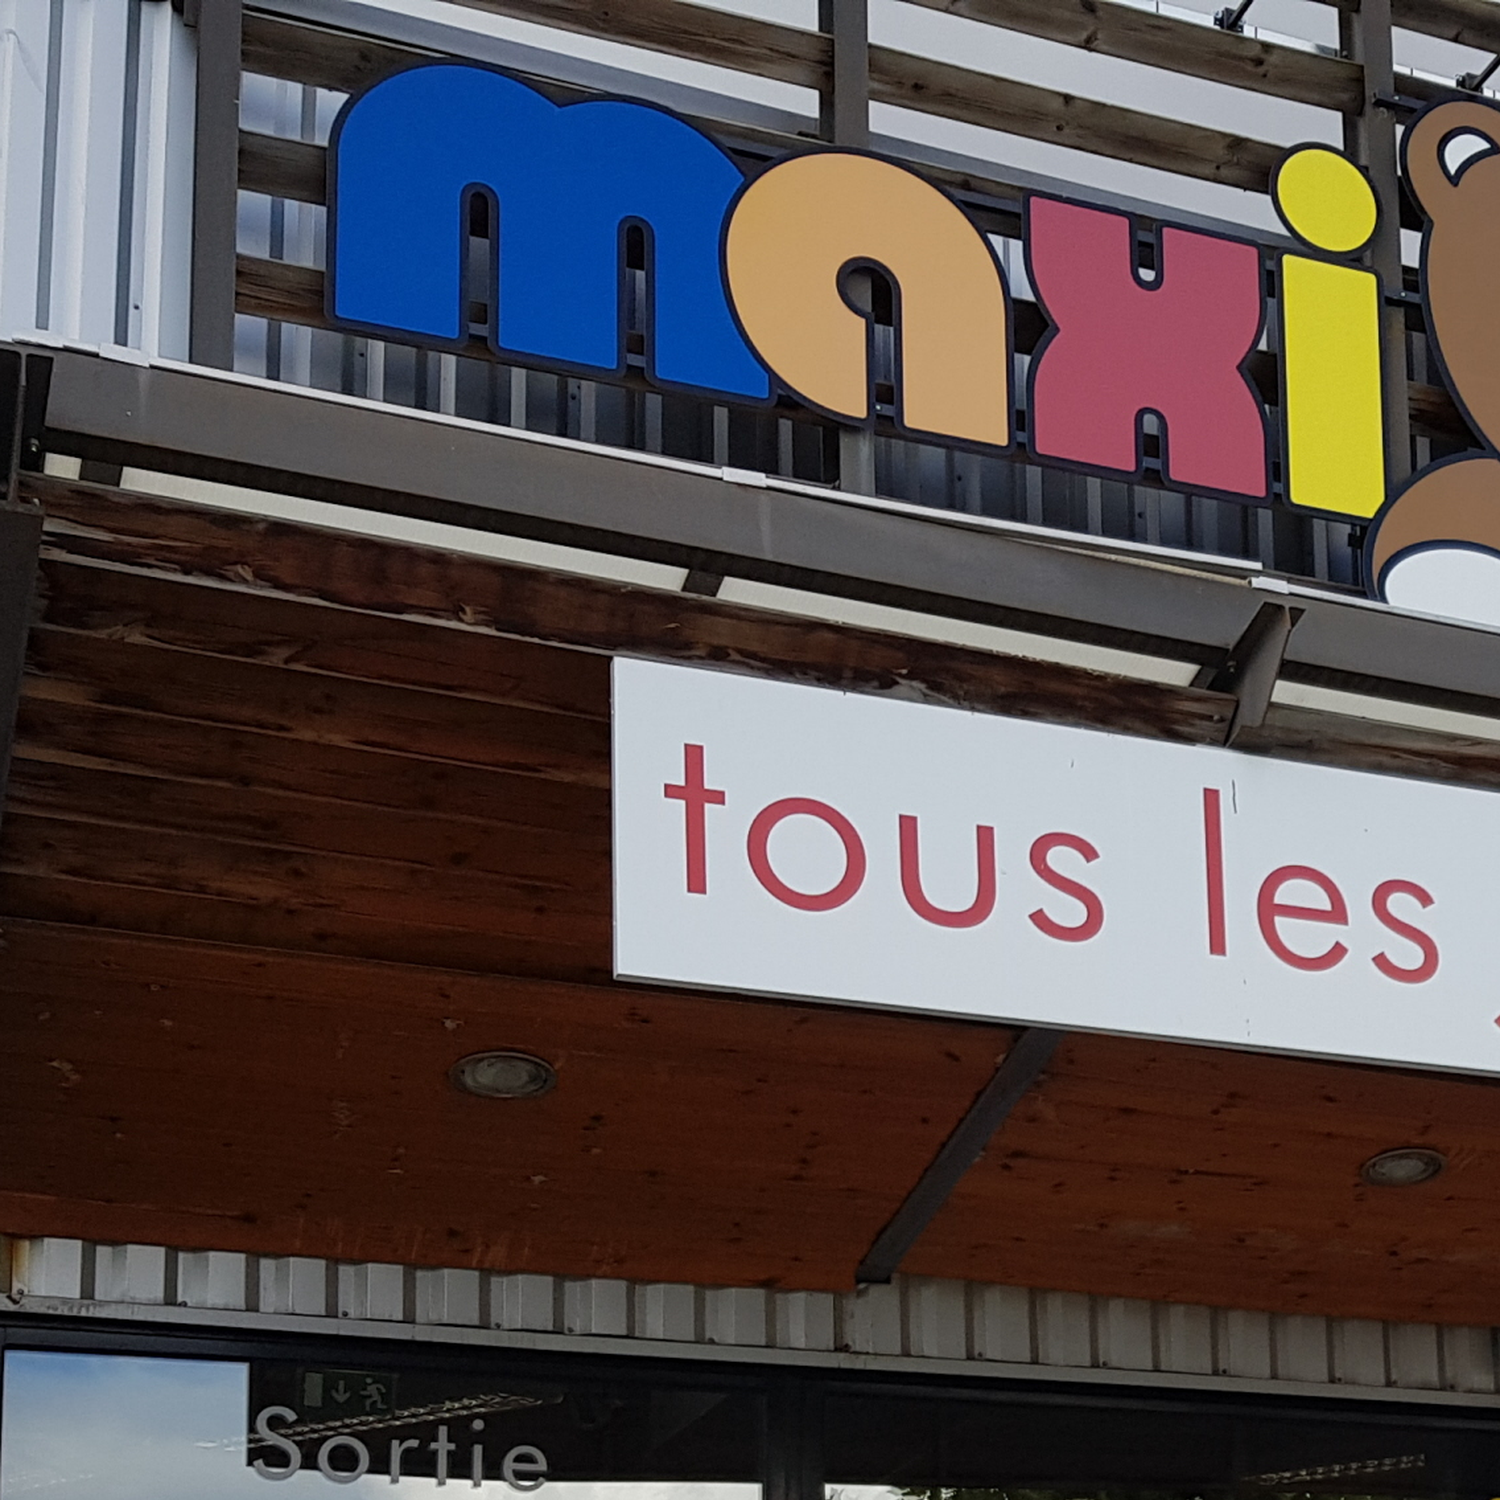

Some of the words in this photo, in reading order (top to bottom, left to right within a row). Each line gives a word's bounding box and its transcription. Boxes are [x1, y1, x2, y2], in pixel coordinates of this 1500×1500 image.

[663, 743, 1105, 942] tous
[1203, 788, 1440, 984] les
[251, 1405, 548, 1492] Sortie
